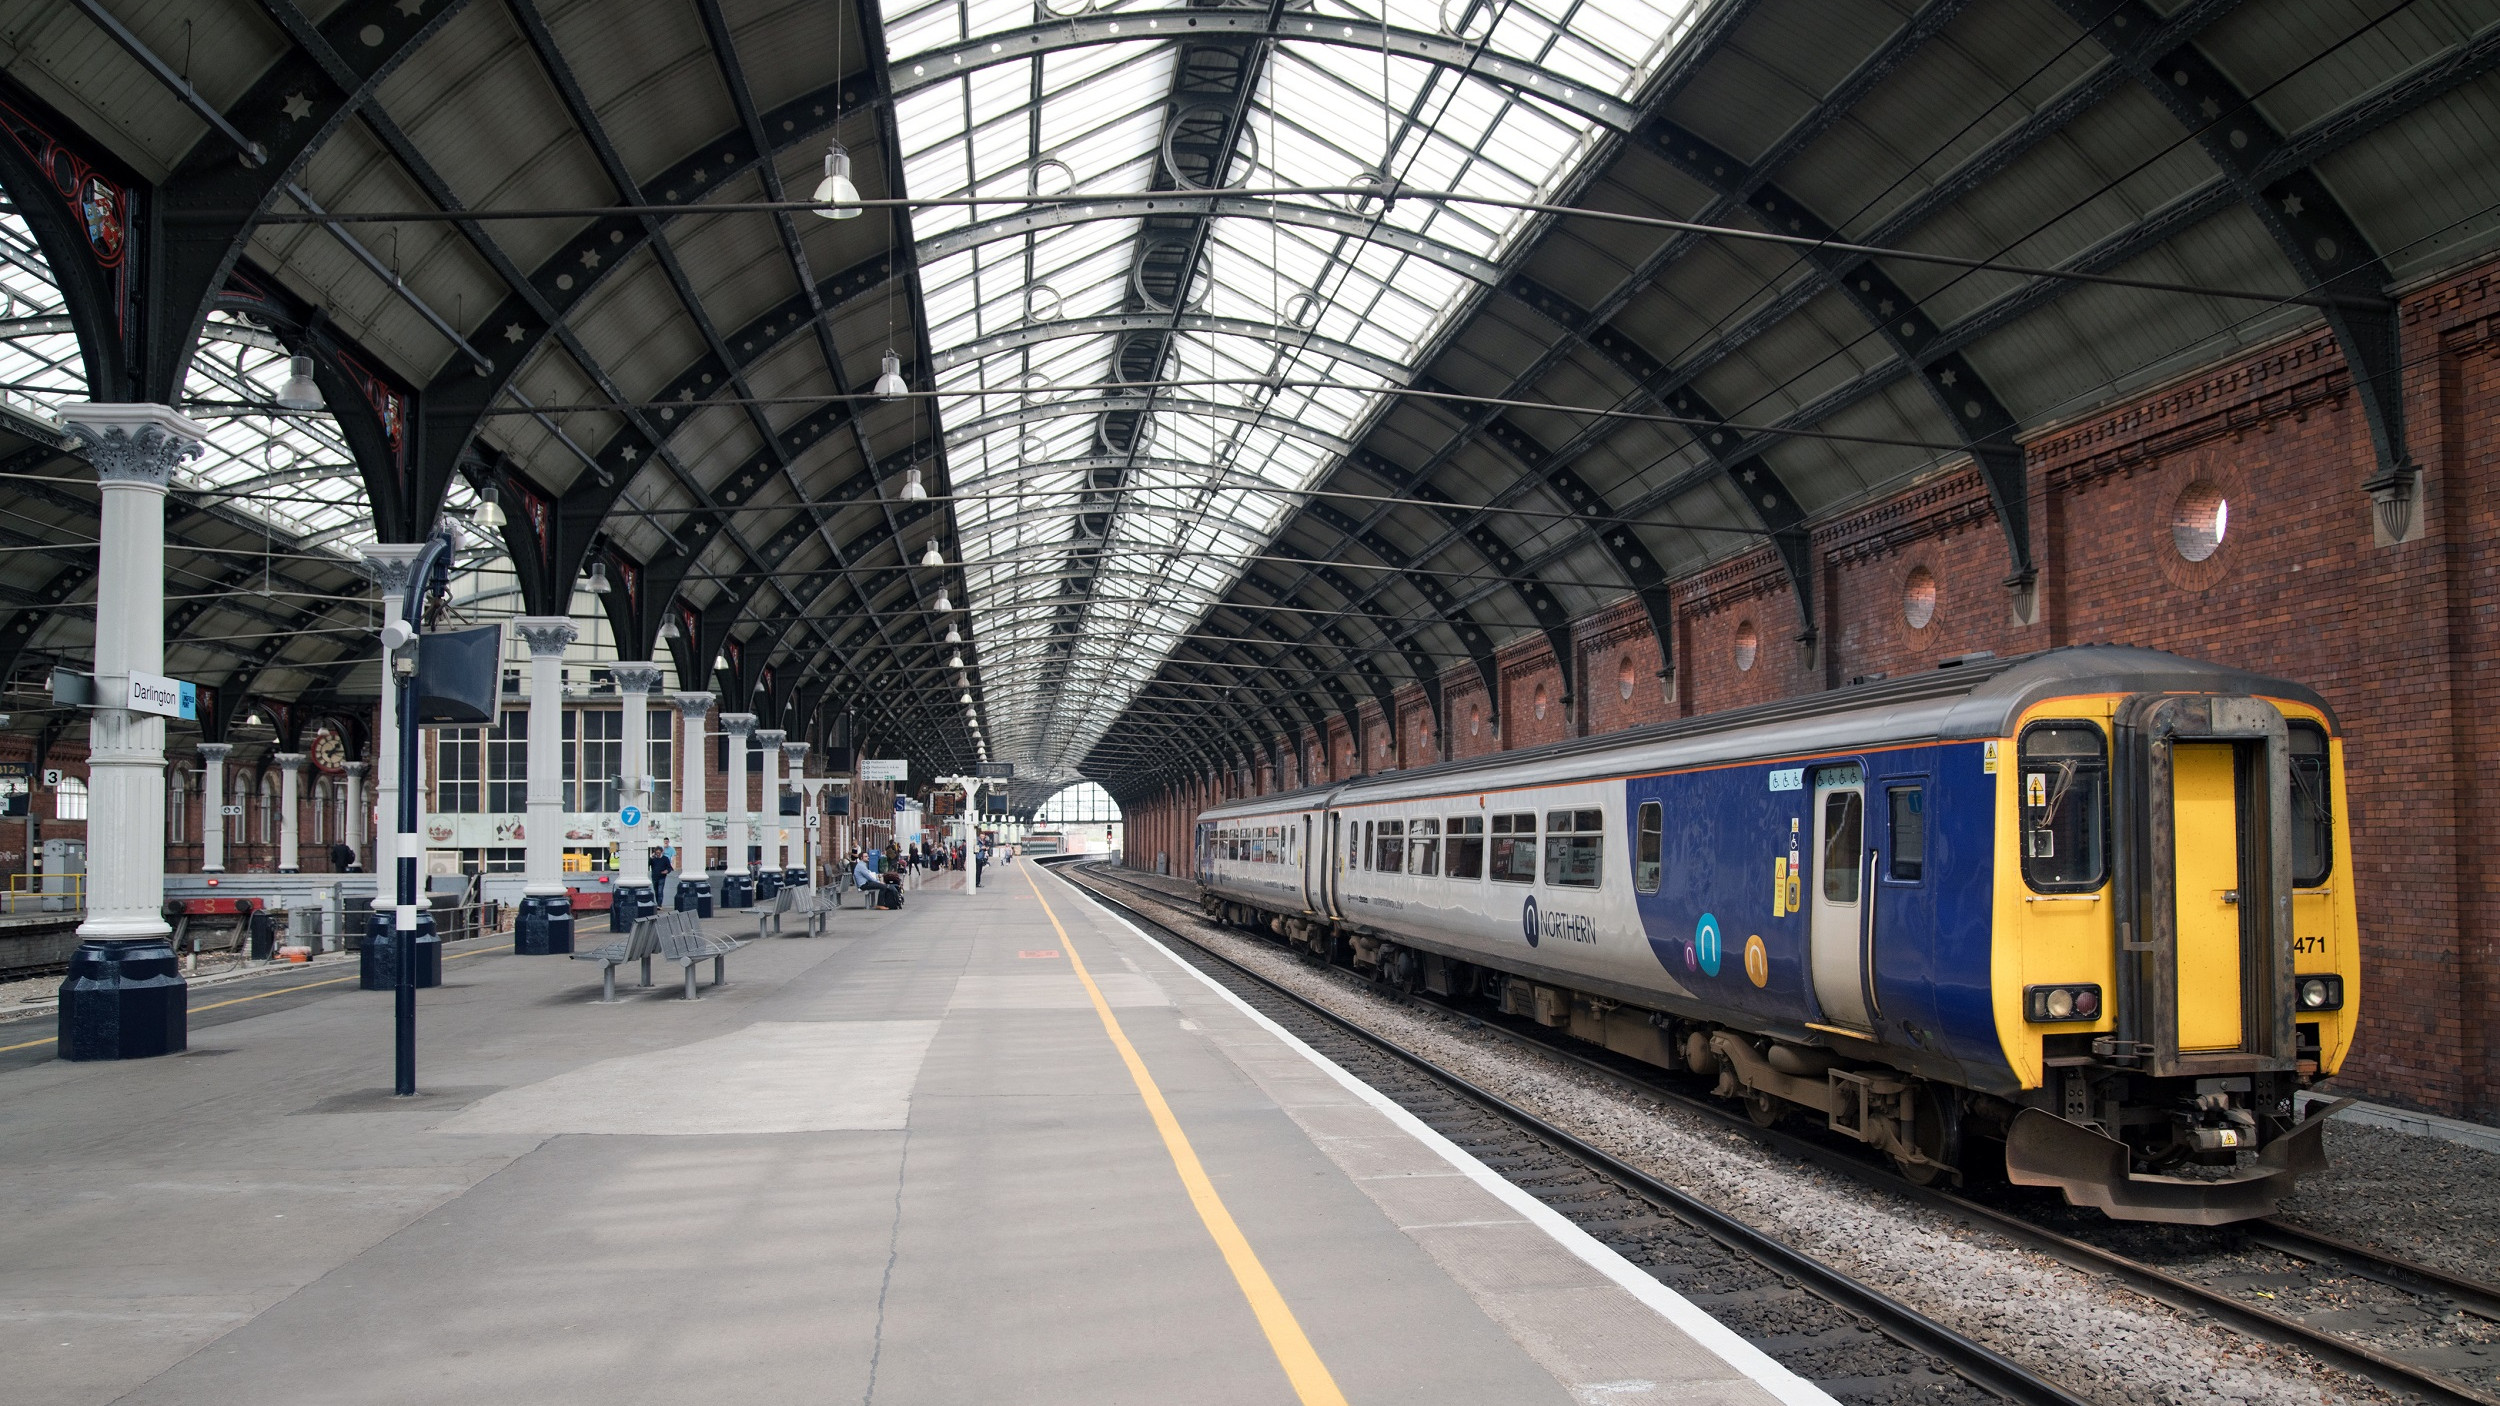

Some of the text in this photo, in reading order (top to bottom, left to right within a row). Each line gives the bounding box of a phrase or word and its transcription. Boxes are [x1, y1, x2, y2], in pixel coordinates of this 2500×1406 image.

[134, 682, 176, 707] Darlington
[48, 771, 58, 783] 3
[626, 811, 636, 823] 7
[809, 815, 817, 826] 2
[968, 812, 974, 822] 1
[203, 898, 216, 913] 3
[589, 894, 602, 907] 2
[1540, 909, 1597, 945] NORTHERN
[2293, 936, 2325, 954] 471
